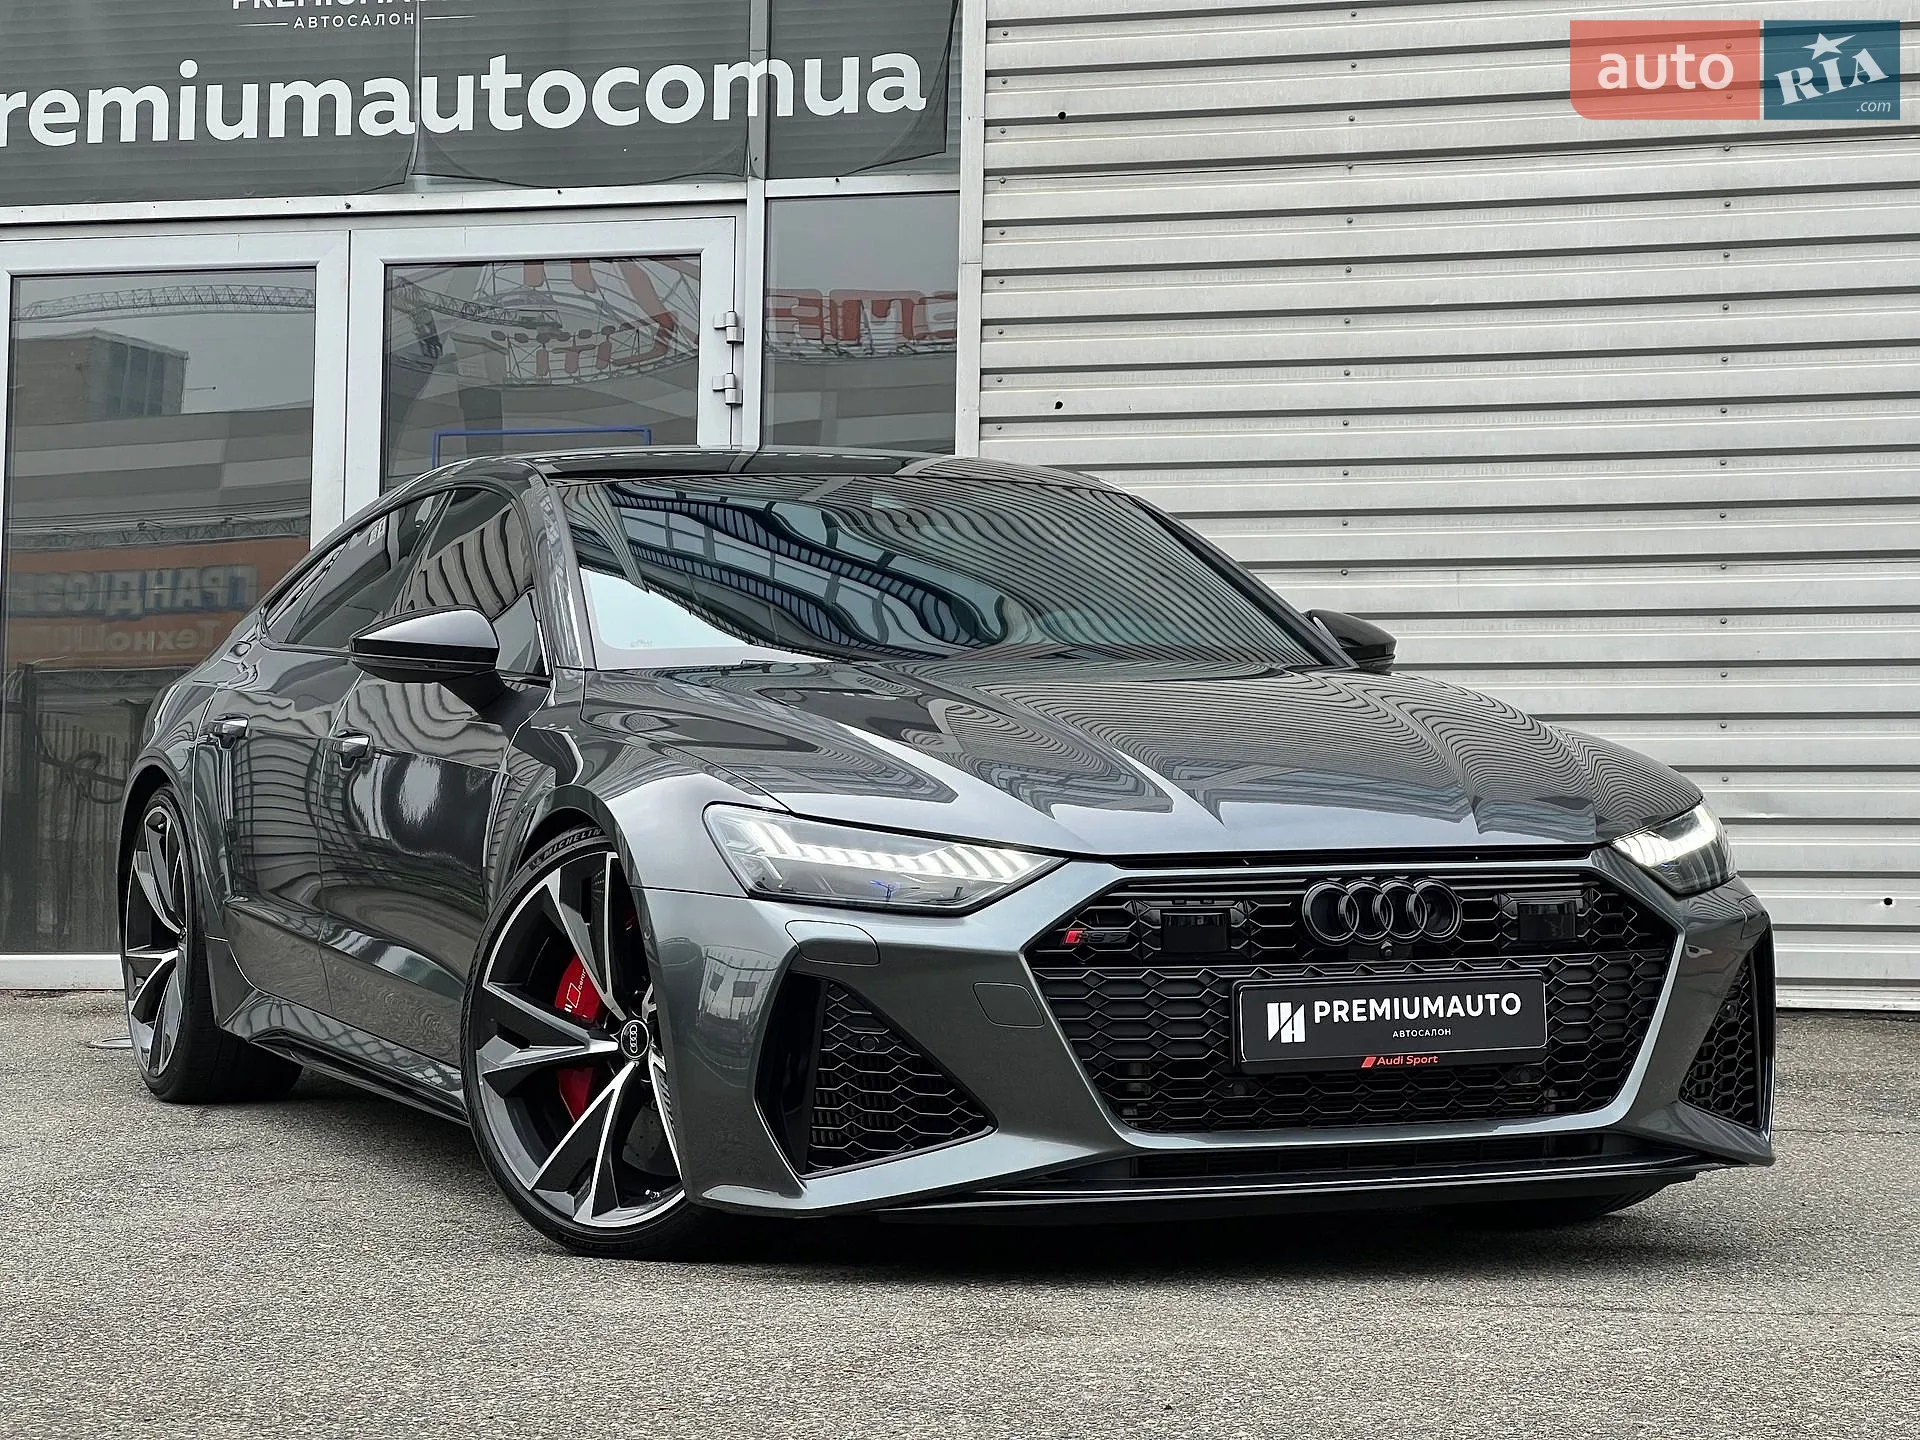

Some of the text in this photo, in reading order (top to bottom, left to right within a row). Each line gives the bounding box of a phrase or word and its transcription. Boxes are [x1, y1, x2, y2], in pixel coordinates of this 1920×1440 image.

[293, 12, 415, 28] АВТОСАЛОН
[543, 828, 602, 860] MICHELIN
[1314, 993, 1522, 1024] PREMIUMAUTO
[1392, 1028, 1452, 1039] АВТОСАЛОН
[1377, 1054, 1439, 1067] Audi Sport
